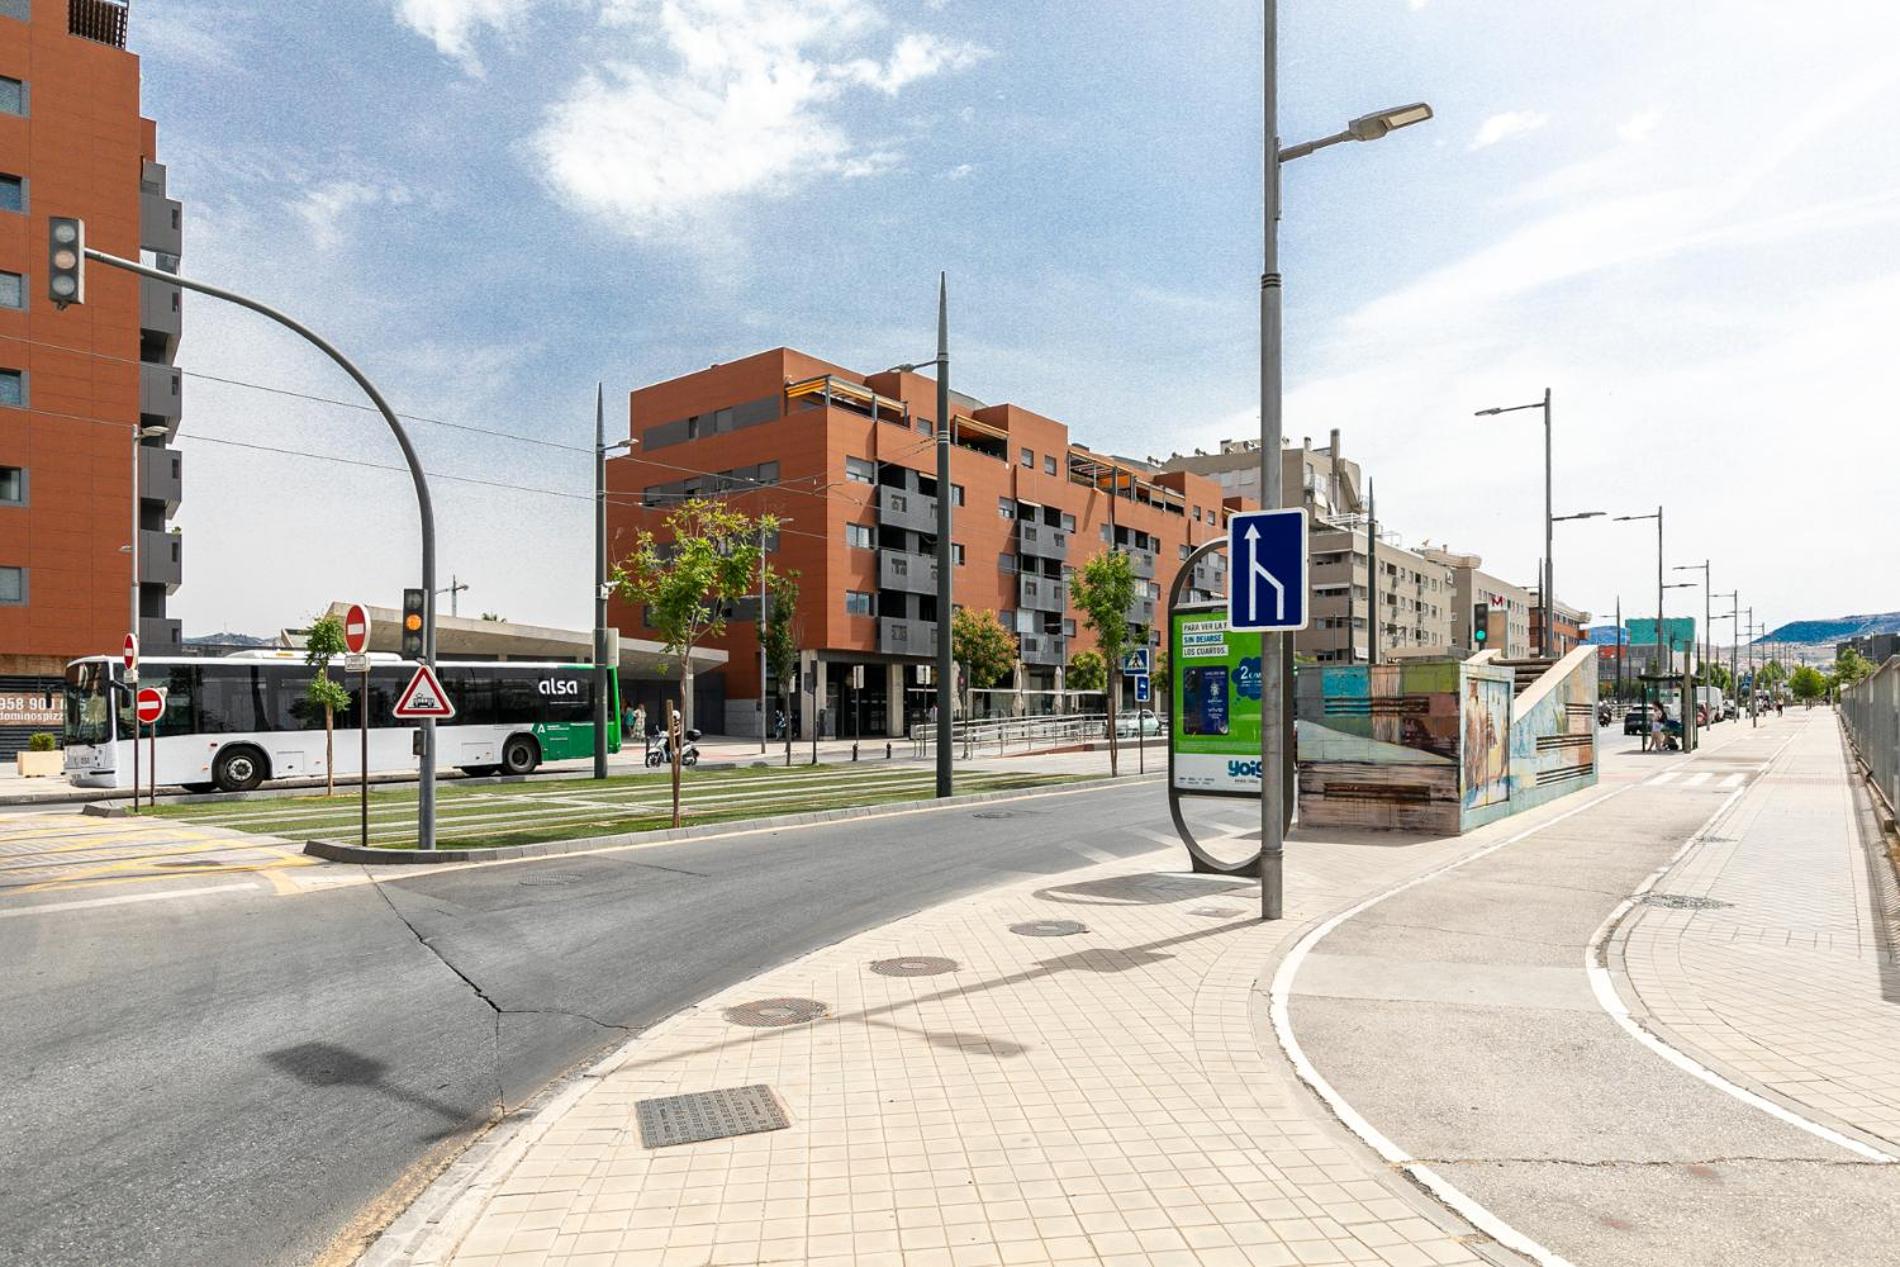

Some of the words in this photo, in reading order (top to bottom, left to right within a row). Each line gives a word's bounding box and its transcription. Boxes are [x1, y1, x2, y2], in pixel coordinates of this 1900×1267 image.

[538, 677, 578, 695] alsa
[0, 711, 64, 721] dominospizz
[1228, 760, 1263, 778] yoig
